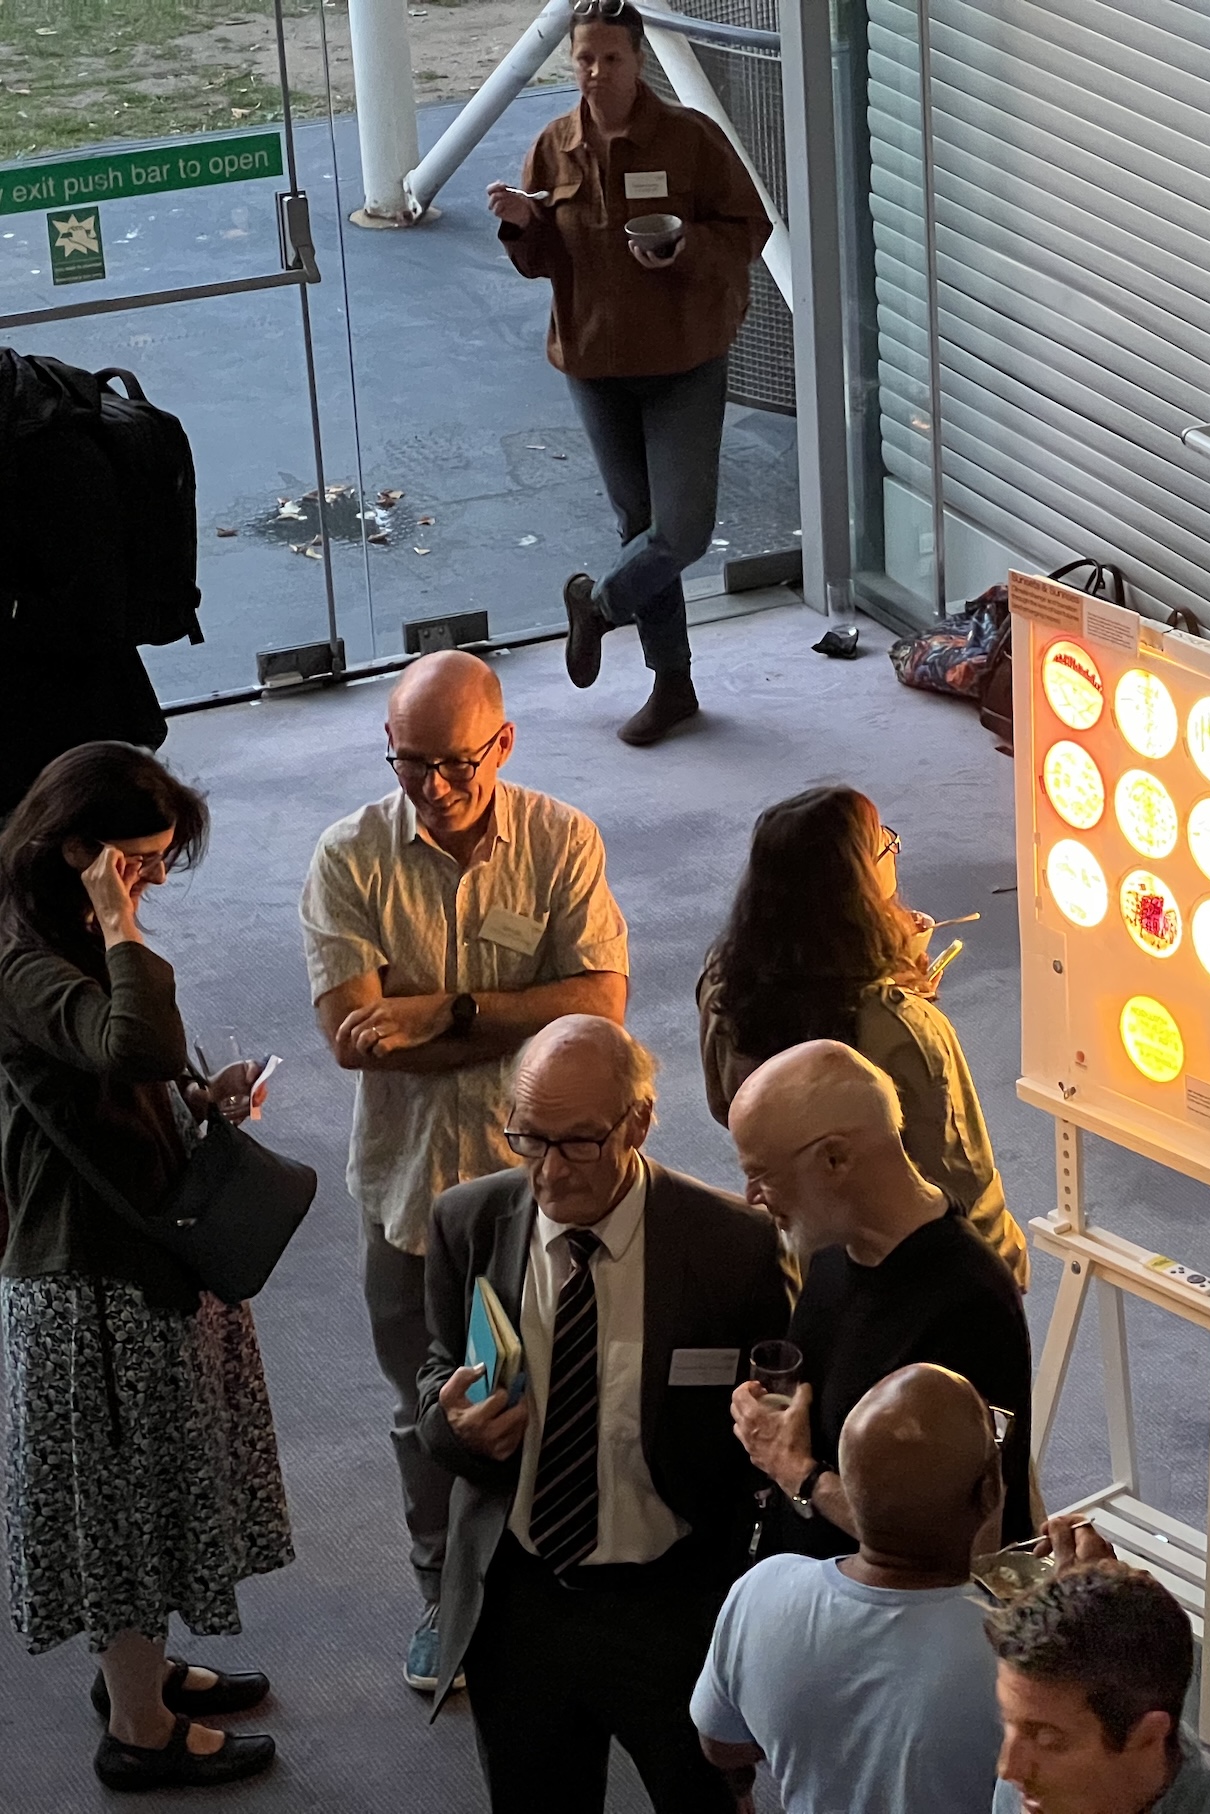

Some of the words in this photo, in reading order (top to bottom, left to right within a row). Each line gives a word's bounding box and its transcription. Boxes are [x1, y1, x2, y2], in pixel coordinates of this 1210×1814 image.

[13, 176, 55, 202] exit
[63, 167, 123, 200] push
[132, 163, 171, 186] bar
[179, 158, 201, 177] to
[208, 150, 269, 177] open
